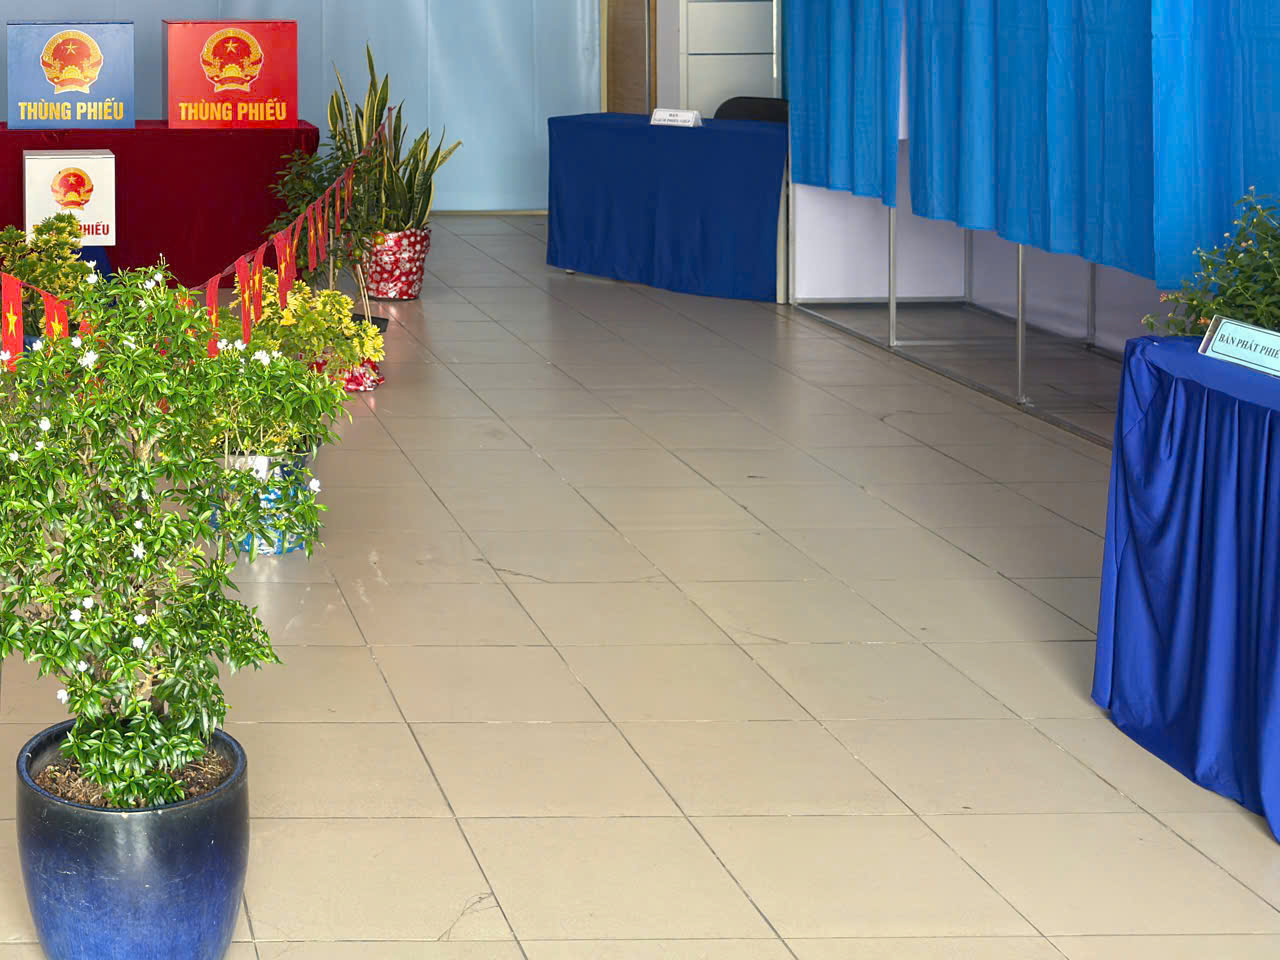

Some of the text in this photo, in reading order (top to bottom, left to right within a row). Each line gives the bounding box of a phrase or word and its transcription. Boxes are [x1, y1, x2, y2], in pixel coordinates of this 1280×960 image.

[18, 97, 124, 120] THÙNG PHIẾU
[178, 97, 287, 121] THÙNG PHIẾU
